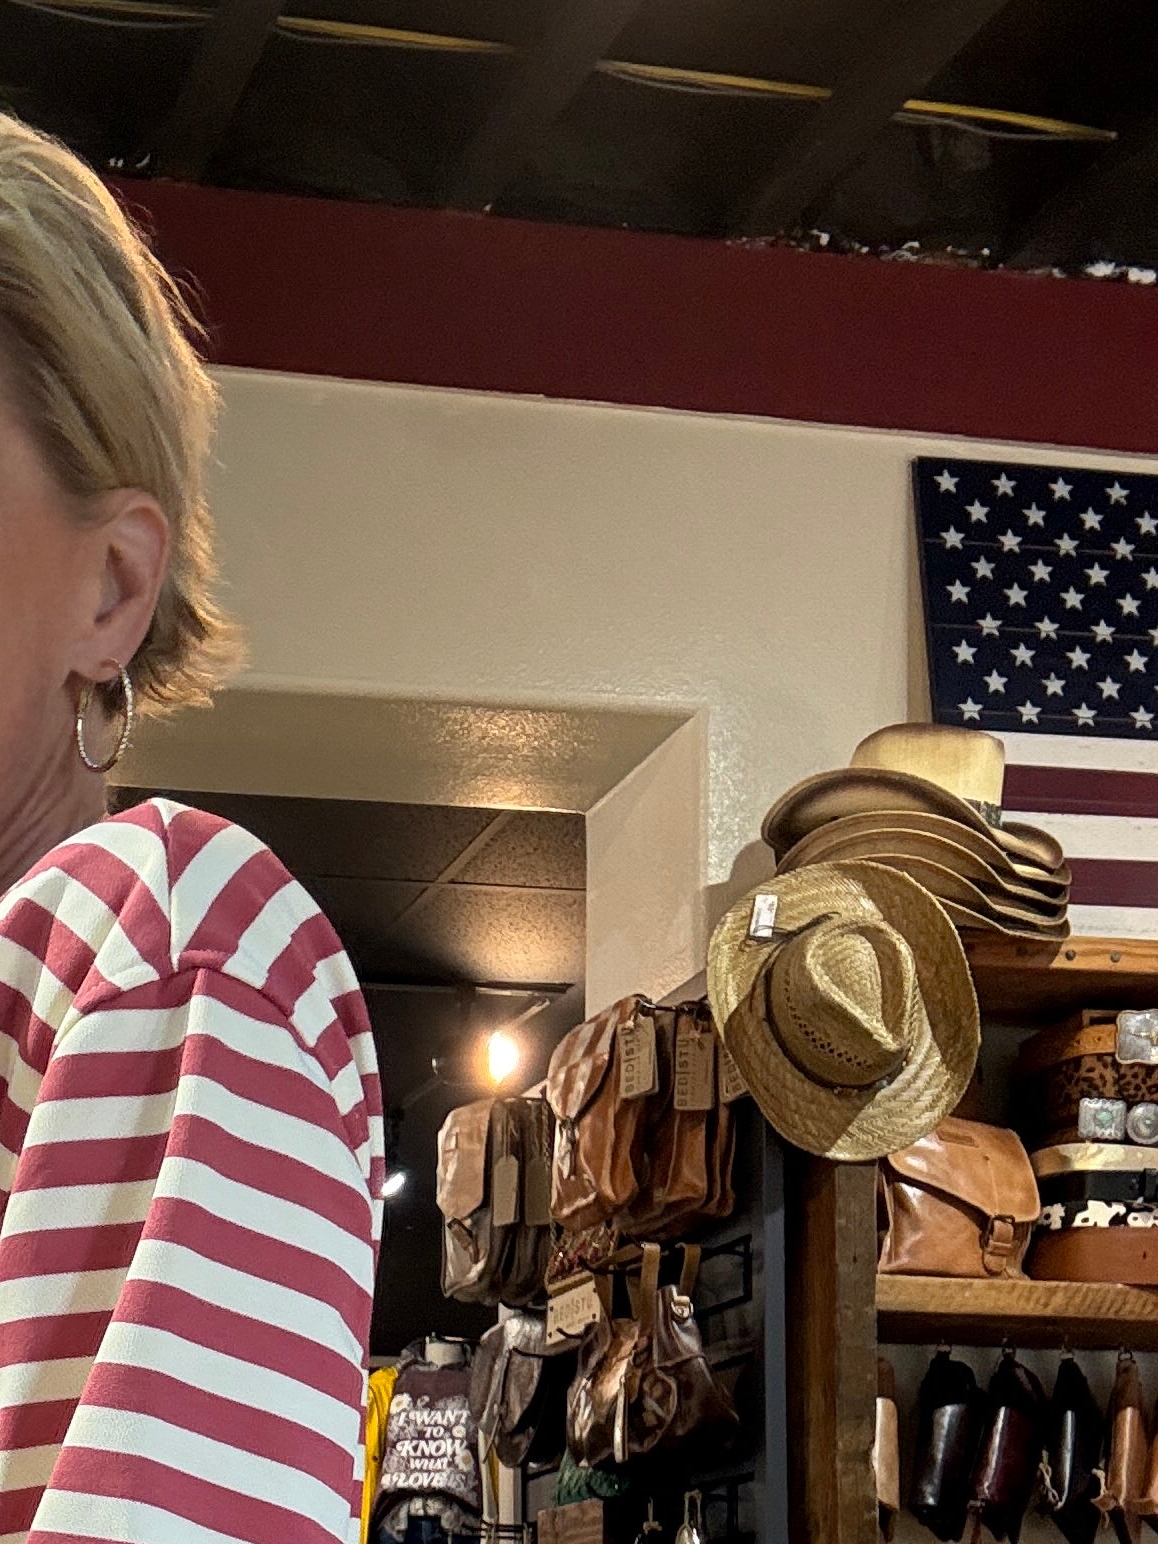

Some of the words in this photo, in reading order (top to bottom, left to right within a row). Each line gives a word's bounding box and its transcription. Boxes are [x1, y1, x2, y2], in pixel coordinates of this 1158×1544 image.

[409, 1409, 471, 1427] WANT
[423, 1426, 444, 1438] TO
[395, 1438, 467, 1459] KNOW
[409, 1457, 448, 1470] WHAT
